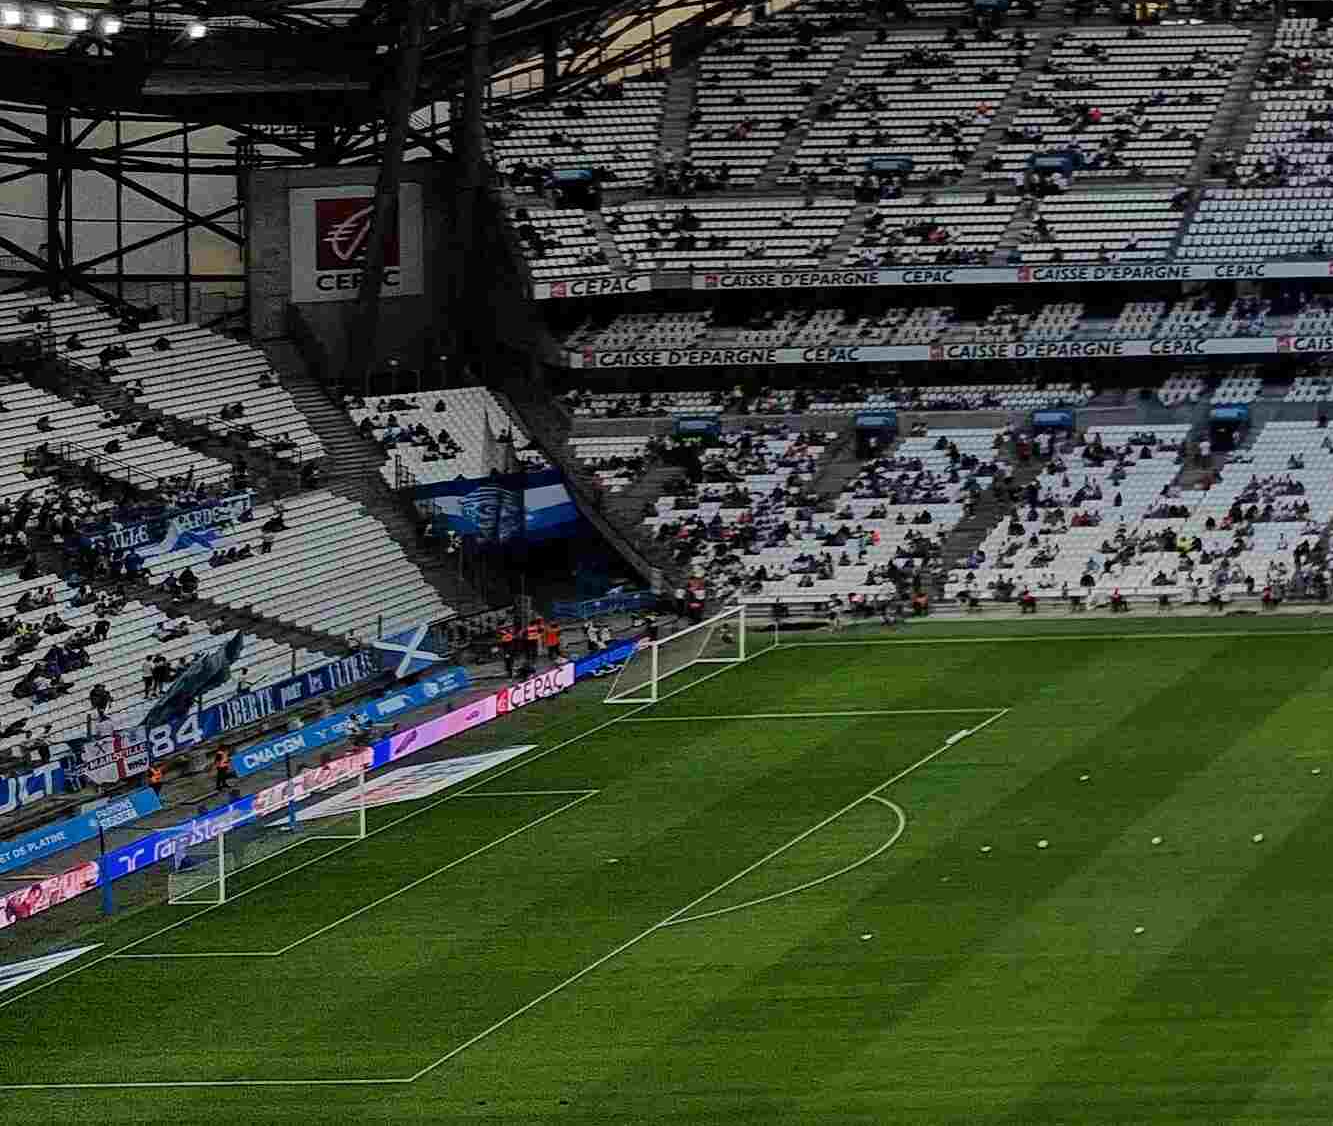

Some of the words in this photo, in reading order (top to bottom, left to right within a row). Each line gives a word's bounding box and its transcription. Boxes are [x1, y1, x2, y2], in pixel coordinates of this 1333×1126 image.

[316, 271, 401, 291] CEPC
[720, 274, 776, 288] CAISSE
[902, 270, 954, 283] CEPAC
[1032, 267, 1091, 281] CAISSE
[1214, 265, 1265, 278] CEPAC
[570, 276, 640, 295] CEPAC
[599, 352, 662, 367] CAISSE
[801, 348, 860, 363] CEPAC
[946, 344, 1009, 359] CAISSE
[1149, 340, 1207, 355] CEPAC
[510, 665, 566, 708] CEPAC
[149, 713, 203, 759] 84
